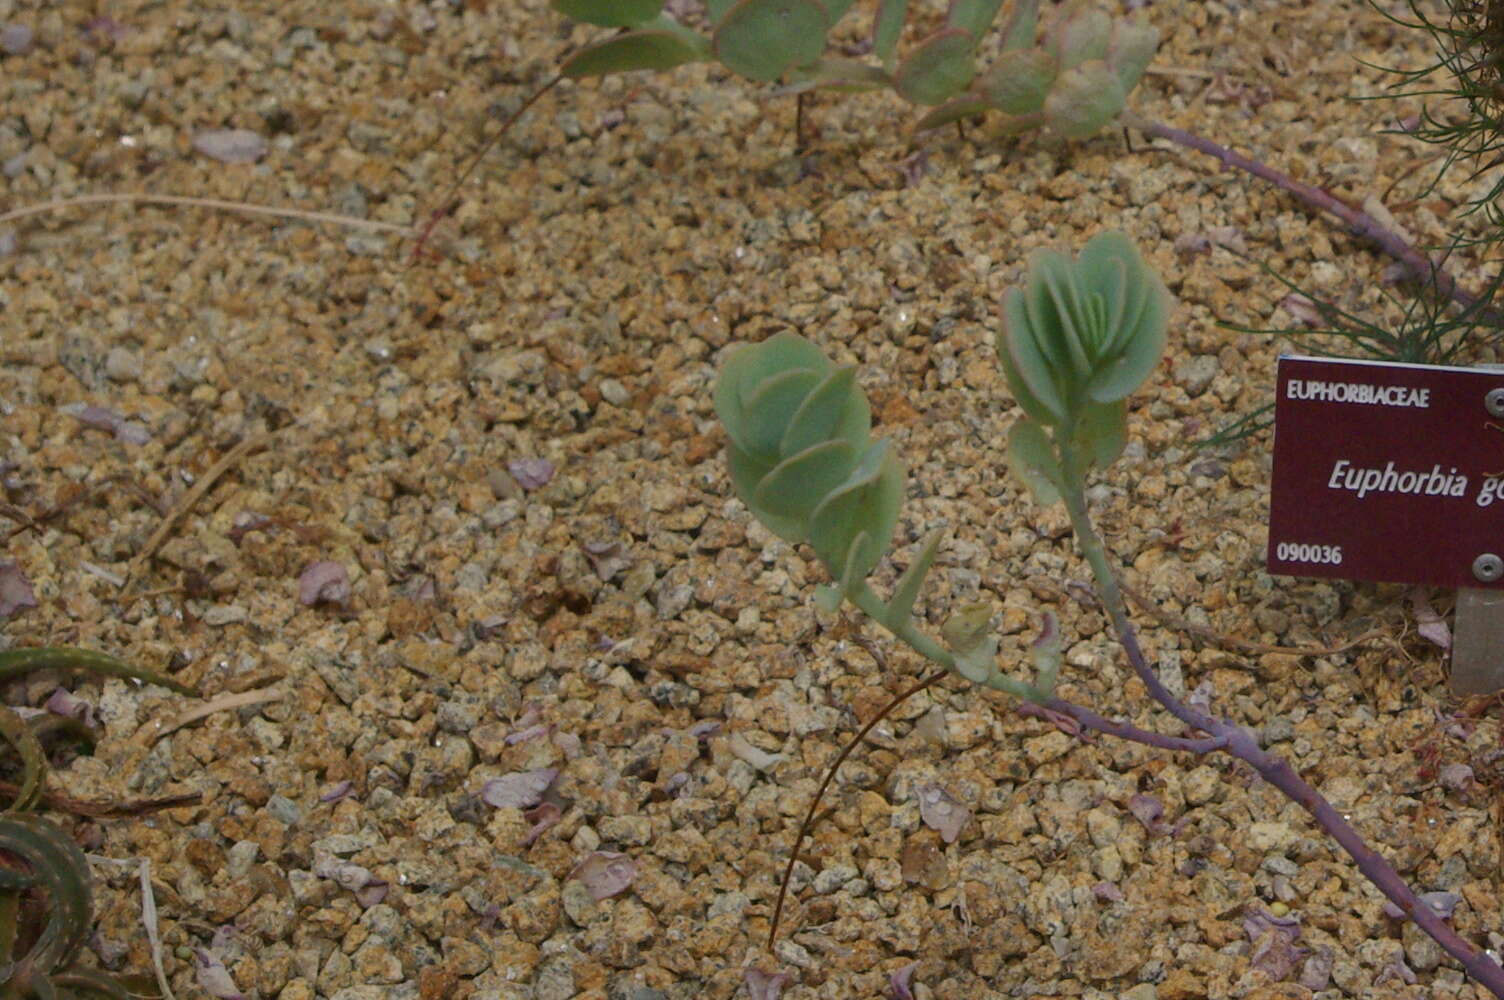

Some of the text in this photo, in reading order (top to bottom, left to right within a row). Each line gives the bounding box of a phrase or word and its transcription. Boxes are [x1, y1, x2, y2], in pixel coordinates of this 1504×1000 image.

[1287, 380, 1429, 407] EUPHORBIACEAE
[1328, 461, 1467, 498] Euphorbia
[1277, 543, 1342, 564] 090036
